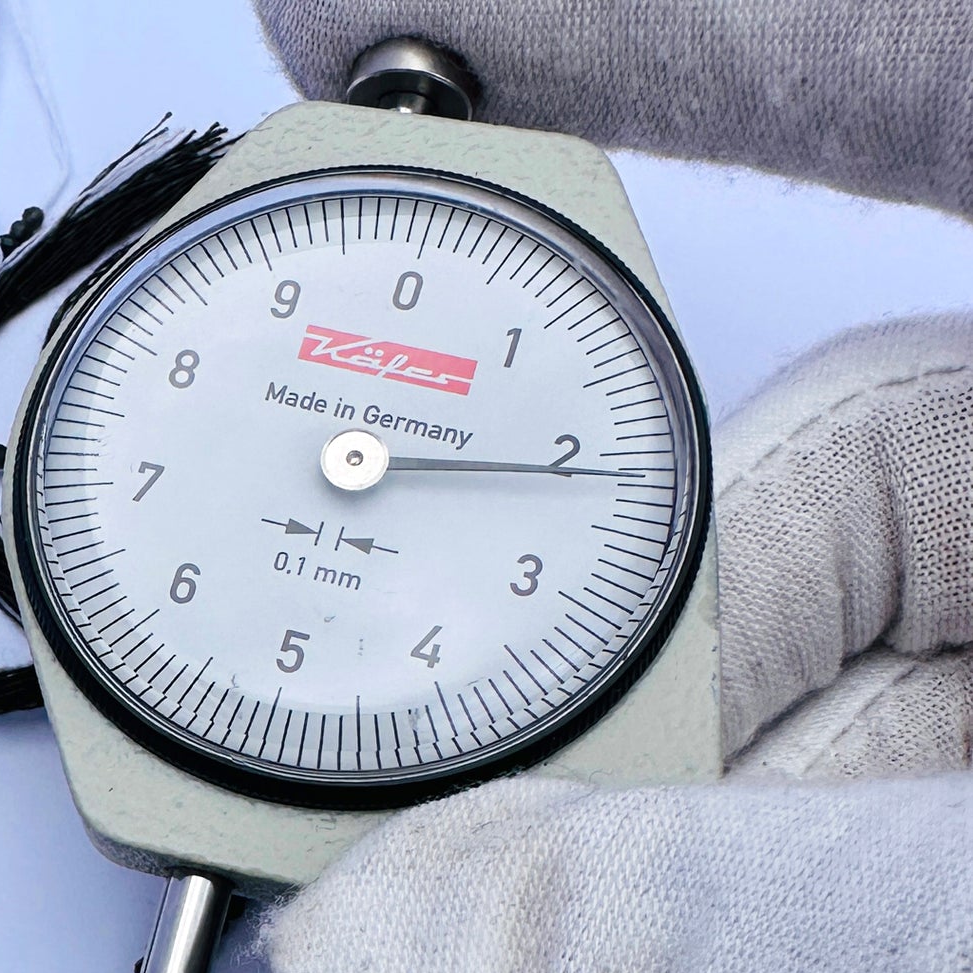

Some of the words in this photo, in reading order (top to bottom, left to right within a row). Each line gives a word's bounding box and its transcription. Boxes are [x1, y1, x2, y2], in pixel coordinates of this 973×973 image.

[271, 280, 301, 318] 9
[392, 271, 423, 310] 0
[503, 327, 522, 367] 1
[169, 350, 199, 389] 8
[265, 383, 327, 415] Made
[334, 398, 355, 420] in
[363, 406, 473, 449] Germany
[549, 435, 580, 477] 2
[132, 461, 164, 502] 7
[170, 563, 201, 603] 6
[274, 551, 306, 576] 0.1
[313, 565, 361, 590] mm
[510, 554, 543, 596] 3
[276, 630, 310, 672] 5
[411, 625, 443, 667] 4
